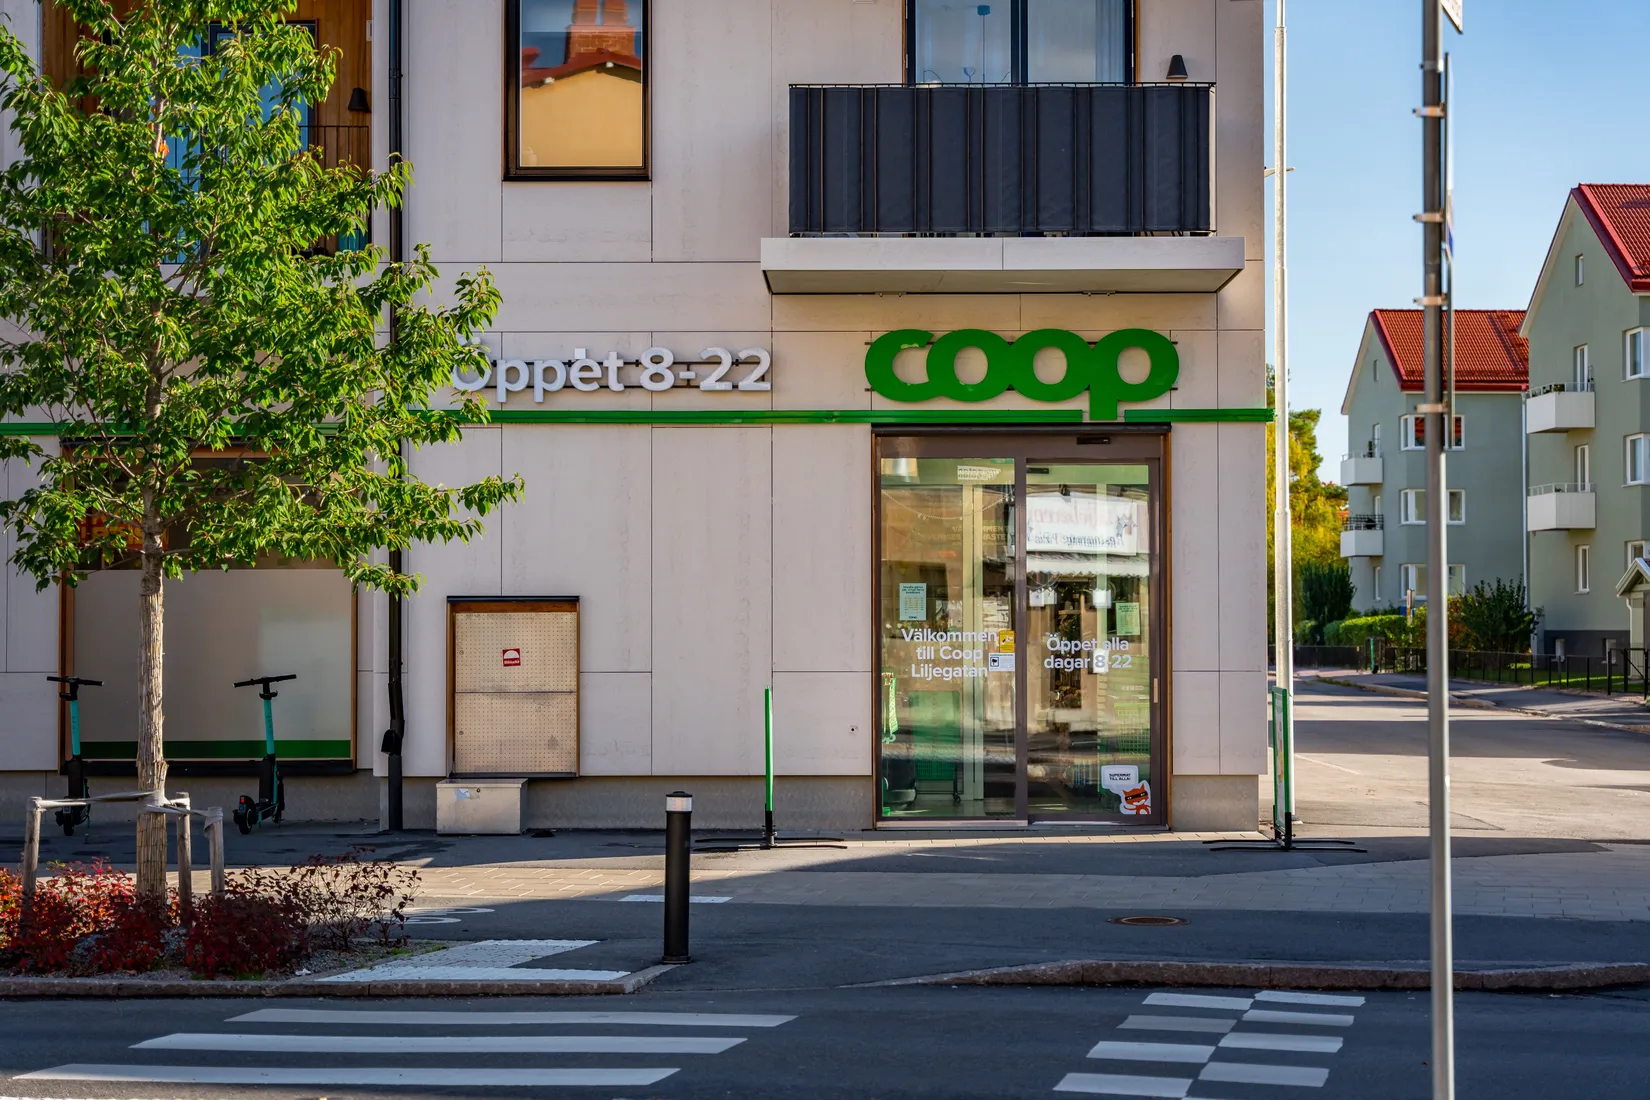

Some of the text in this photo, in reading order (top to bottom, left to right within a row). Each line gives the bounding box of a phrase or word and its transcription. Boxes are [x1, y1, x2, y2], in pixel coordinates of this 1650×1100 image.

[451, 336, 772, 402] Öppet 8-22
[865, 328, 1180, 420] coop
[901, 628, 998, 642] Välkommen
[1046, 633, 1129, 655] Öppet alla
[916, 646, 935, 660] till
[940, 646, 984, 663] Coop
[1043, 654, 1132, 672] dagar 8-22
[911, 663, 988, 681] Liljegatan
